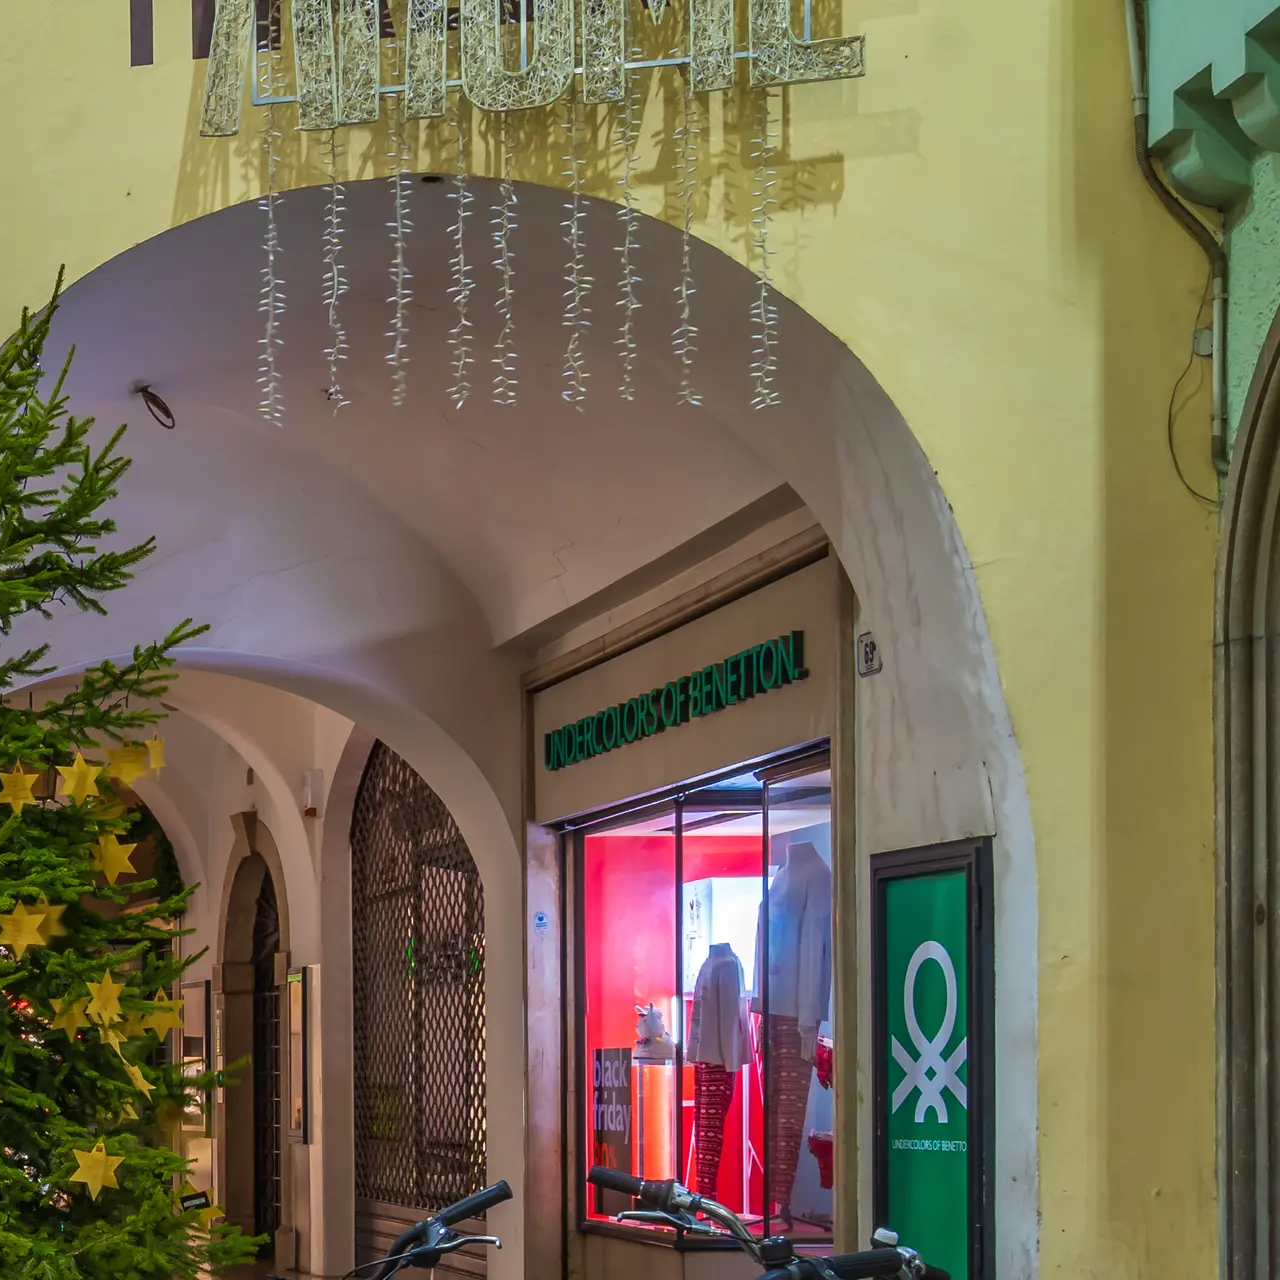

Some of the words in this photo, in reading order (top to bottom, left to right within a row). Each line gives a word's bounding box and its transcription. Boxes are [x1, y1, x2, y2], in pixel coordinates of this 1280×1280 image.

[544, 690, 660, 770] UNDERCOLORS
[661, 676, 690, 727] OF
[593, 1048, 628, 1088] black
[593, 1090, 632, 1145] friday
[892, 1139, 932, 1150] UNDERCOLORS
[932, 1140, 941, 1151] OF
[942, 1140, 967, 1152] BENETTO
